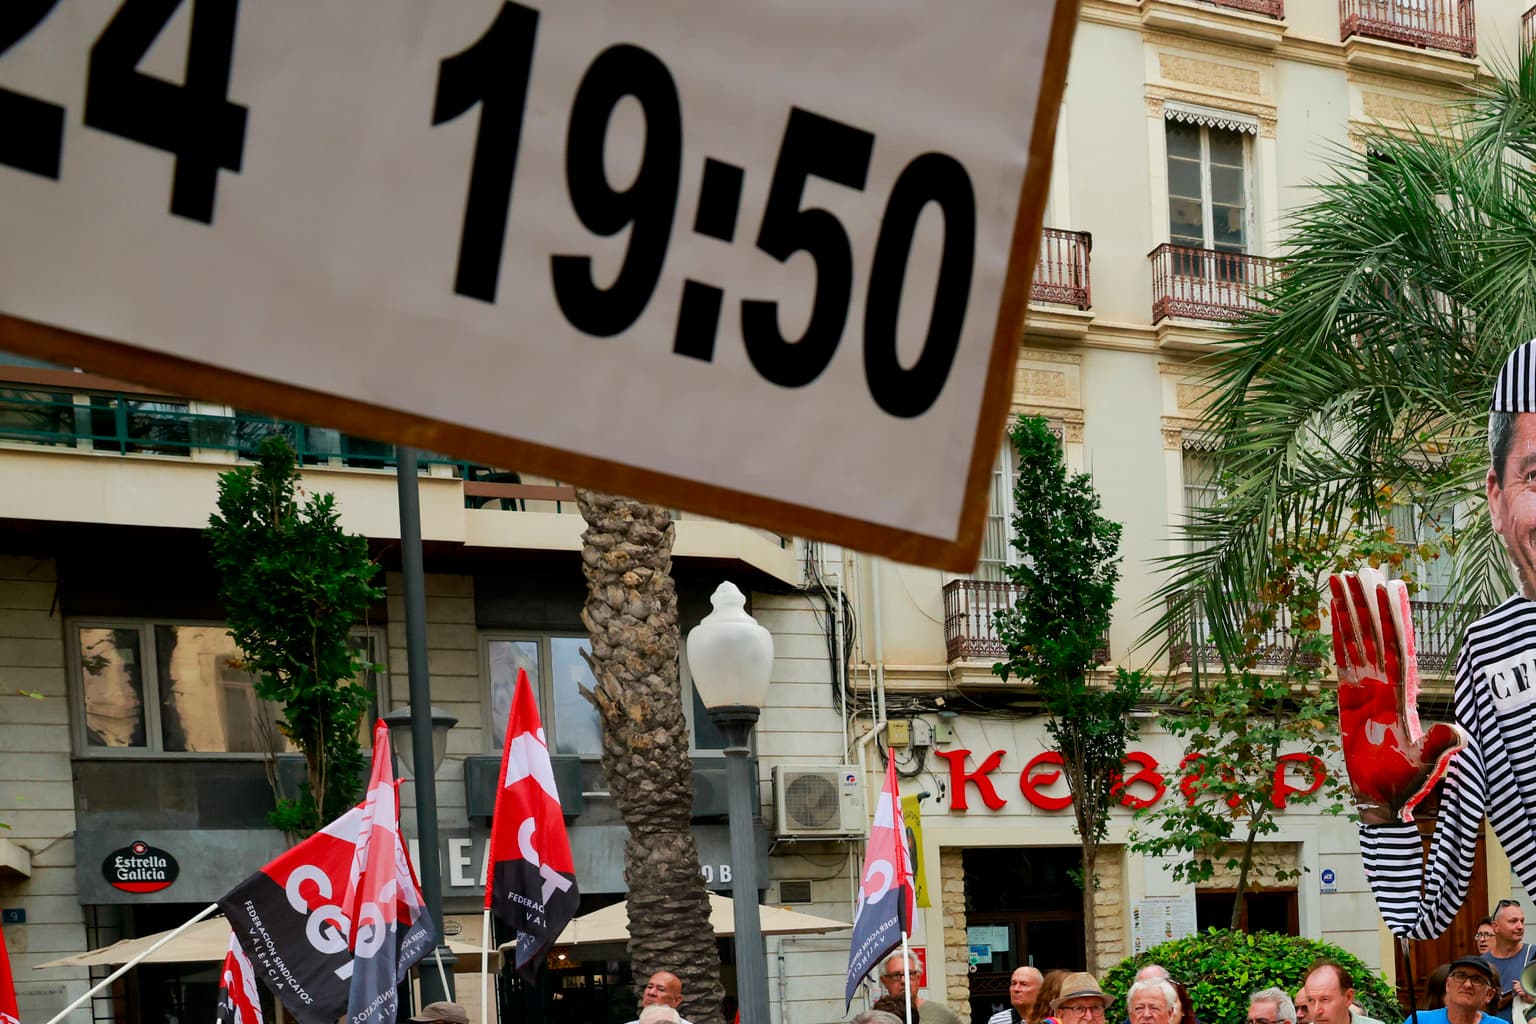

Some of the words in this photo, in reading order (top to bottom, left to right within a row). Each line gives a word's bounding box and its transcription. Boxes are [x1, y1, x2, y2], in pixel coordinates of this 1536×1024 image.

[431, 0, 976, 419] 19:50
[115, 856, 167, 868] Estrella
[117, 868, 166, 880] Galicia
[10, 911, 18, 921] 9
[271, 953, 314, 1005] SINDICATOS
